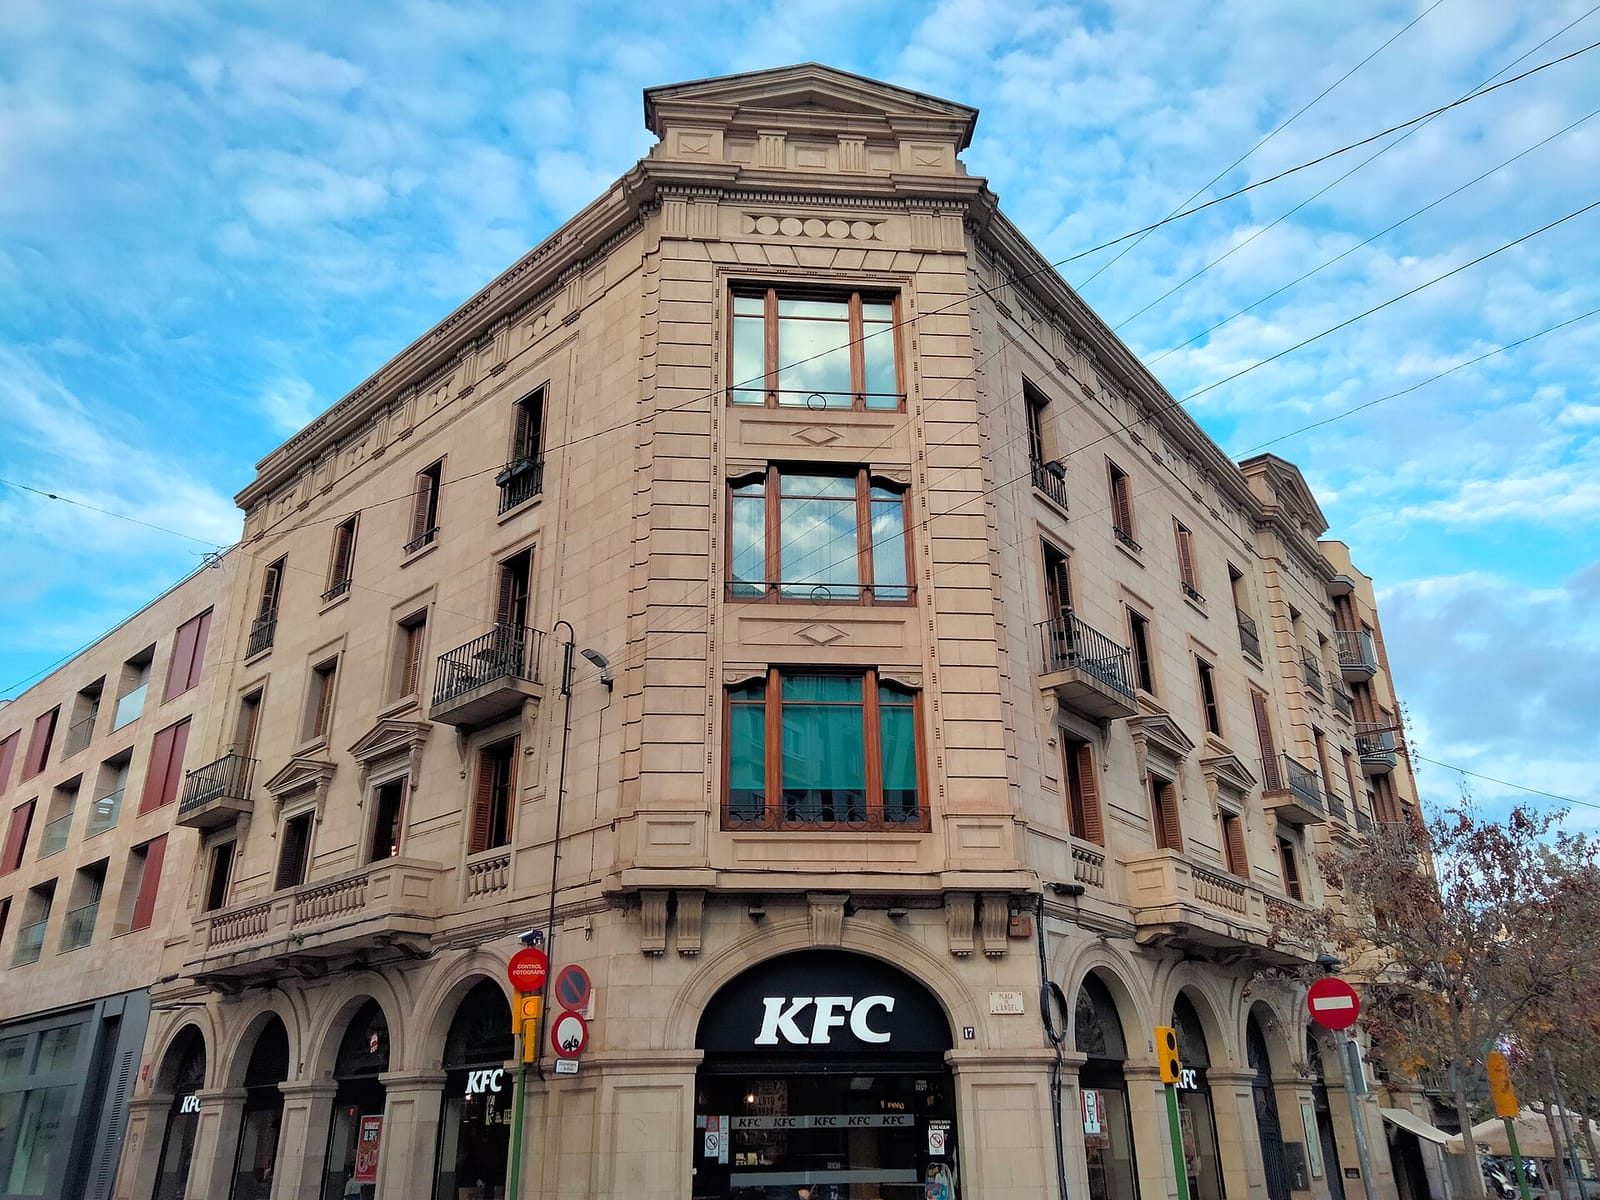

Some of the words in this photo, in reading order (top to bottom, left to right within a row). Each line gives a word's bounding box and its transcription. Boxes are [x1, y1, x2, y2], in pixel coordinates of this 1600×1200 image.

[754, 995, 895, 1045] KFC
[964, 1028, 973, 1039] 17
[465, 1069, 504, 1094] KFC
[738, 1118, 761, 1127] KFC
[773, 1118, 796, 1127] KFC
[813, 1117, 837, 1126] KFC
[848, 1116, 871, 1125] KFC
[882, 1116, 905, 1125] KFC
